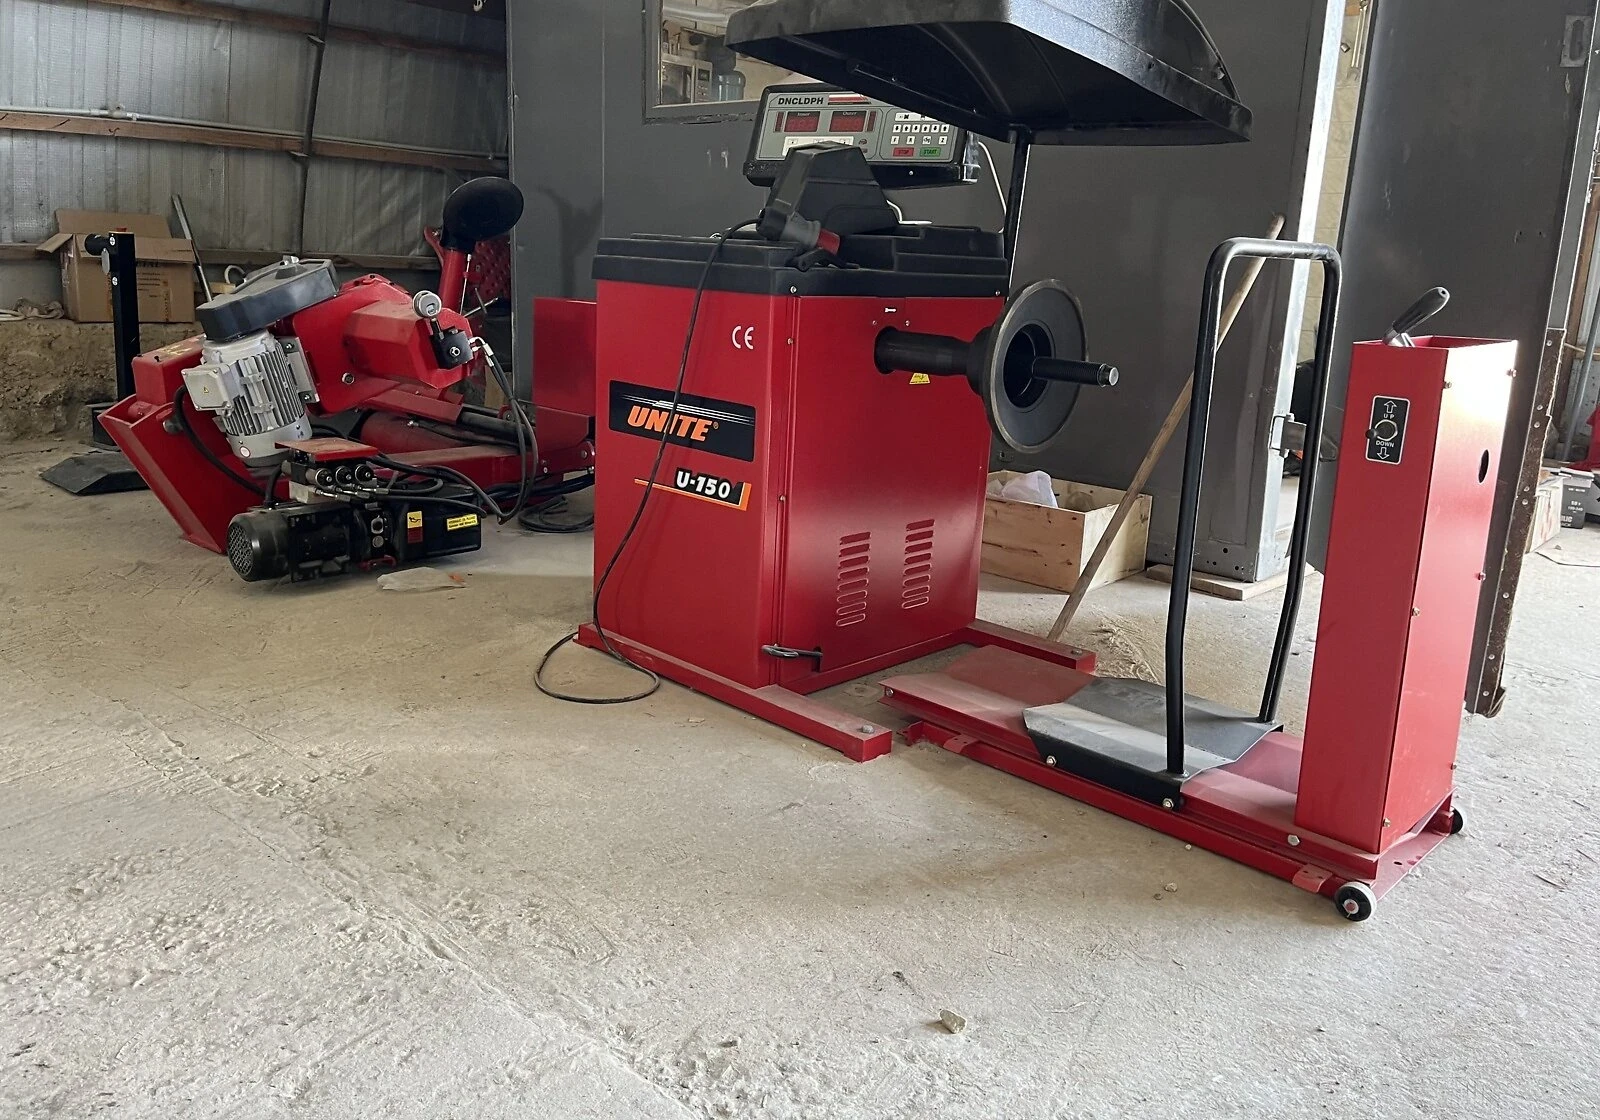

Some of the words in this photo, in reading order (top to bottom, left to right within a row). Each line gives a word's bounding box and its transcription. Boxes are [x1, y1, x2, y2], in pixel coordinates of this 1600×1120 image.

[778, 97, 824, 105] DNCLDPH
[1375, 440, 1395, 448] DOWN
[676, 470, 731, 499] U-150
